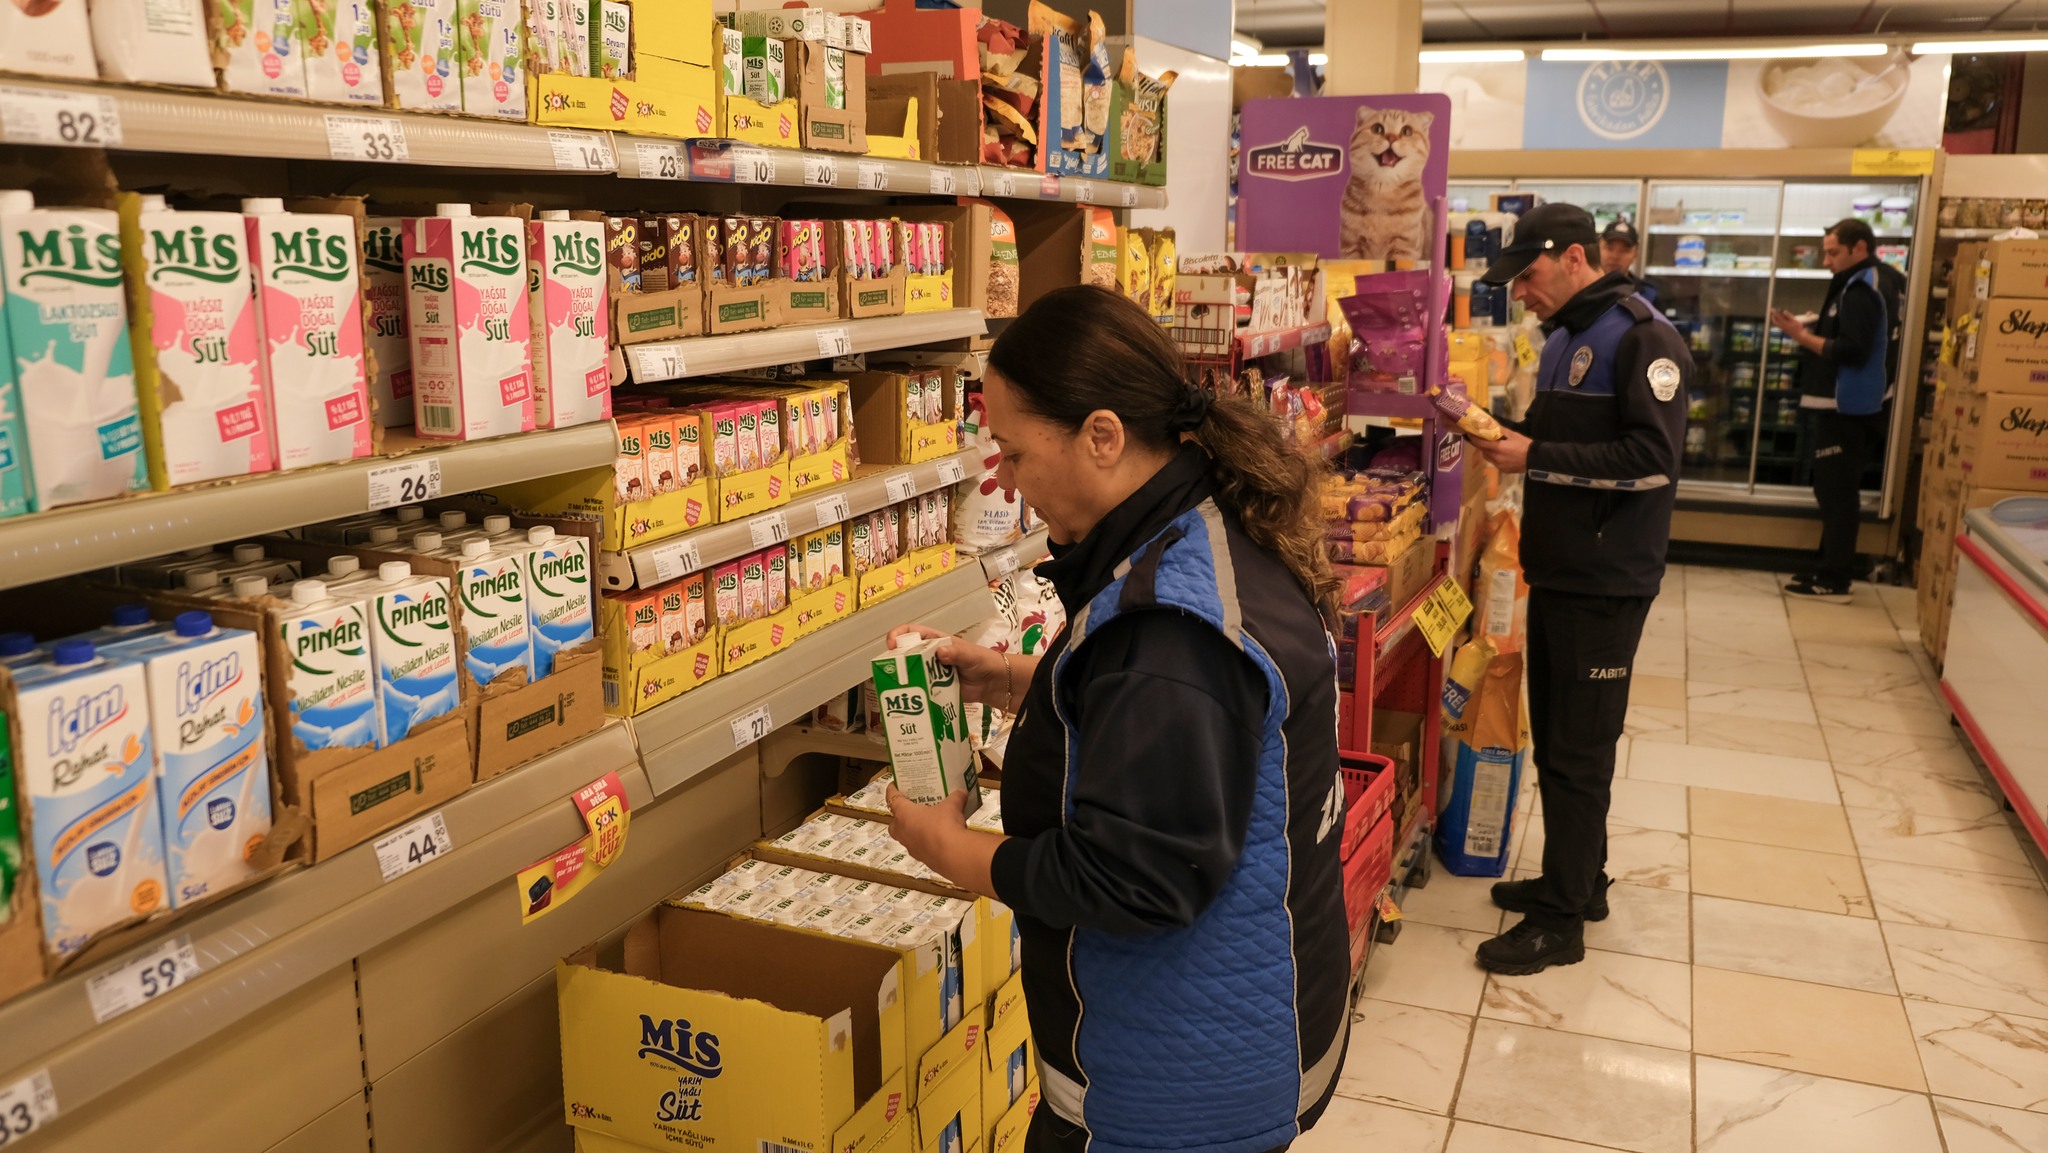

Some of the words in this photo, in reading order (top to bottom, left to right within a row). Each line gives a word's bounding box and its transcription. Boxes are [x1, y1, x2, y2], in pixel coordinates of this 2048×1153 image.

[606, 38, 625, 49] Devam
[58, 110, 100, 142] 82
[363, 132, 394, 159] 33
[580, 147, 603, 169] 14
[659, 156, 676, 178] 23
[1257, 155, 1295, 170] FREE
[1299, 153, 1333, 170] CAT
[754, 161, 768, 183] 10
[818, 165, 831, 184] 20
[874, 172, 882, 190] 17
[480, 286, 507, 300] YAĞSIZ
[572, 286, 593, 299] YAĞSIZ
[481, 299, 508, 315] DOĞAL
[572, 299, 594, 313] DOĞAL
[377, 315, 402, 338] Süt
[425, 311, 440, 325] Süt
[575, 316, 595, 337] Süt
[485, 318, 510, 341] Süt
[192, 337, 229, 363] Süt
[306, 332, 338, 357] Süt
[952, 467, 960, 480] 11
[401, 475, 427, 502] 26
[902, 482, 910, 496] 11
[834, 504, 844, 520] 11
[772, 523, 783, 541] 11
[680, 553, 692, 572] 11
[538, 606, 564, 628] Nesilden
[565, 594, 587, 614] Nesile
[573, 605, 588, 620] Lezzet
[469, 624, 499, 650] Nesilden
[500, 613, 523, 635] Nesile
[509, 626, 524, 642] Lezzet
[391, 655, 424, 682] Nesilden
[425, 641, 449, 668] Nesile
[434, 656, 451, 672] Lezzet
[1589, 666, 1628, 680] ZABITA
[296, 675, 335, 711] Nesilden
[336, 668, 366, 693] Nesile
[942, 702, 958, 726] Süt
[751, 717, 764, 738] 27
[900, 723, 917, 735] Süt
[580, 787, 594, 801] ARA
[593, 779, 608, 793] SIRA
[590, 792, 607, 807] DEĞİL
[600, 825, 618, 845] HEP
[408, 834, 437, 863] 44
[595, 836, 621, 864] UCUZ
[141, 958, 175, 998] 59
[678, 1076, 702, 1087] YARIM
[679, 1087, 702, 1097] YAĞLI
[656, 1091, 702, 1122] Süt
[653, 1122, 676, 1134] YARIM
[677, 1127, 700, 1140] YAĞLI
[700, 1134, 716, 1145] UHT
[665, 1132, 684, 1144] İÇME
[684, 1138, 704, 1149] SÜTÜ
